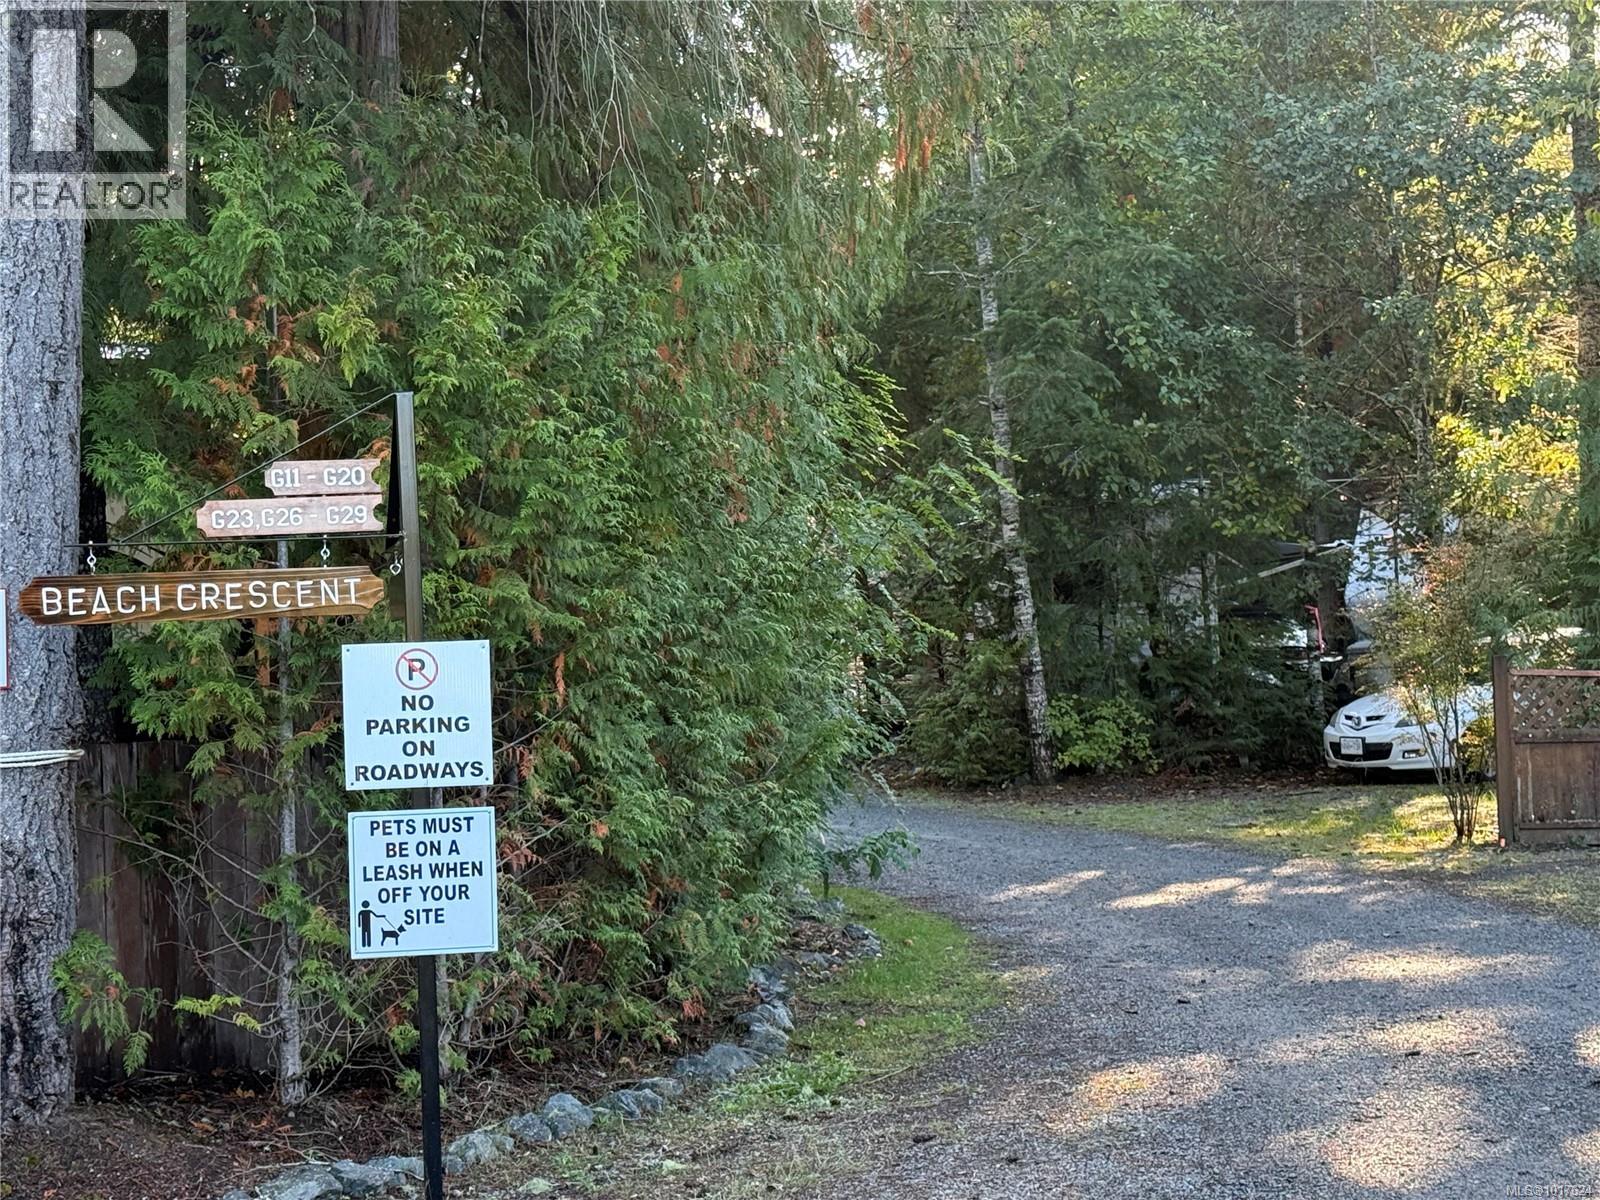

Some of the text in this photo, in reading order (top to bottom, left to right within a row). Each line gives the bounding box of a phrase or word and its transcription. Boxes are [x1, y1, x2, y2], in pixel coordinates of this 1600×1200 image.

[270, 468, 300, 488] G11
[323, 465, 366, 486] G20
[326, 504, 368, 525] G29
[41, 577, 362, 616] BEACH CRESCENT
[401, 694, 434, 711] NO
[366, 716, 470, 735] PARKING
[402, 740, 435, 757] ON
[355, 761, 484, 782] ROADWAYS
[370, 816, 474, 836] PETS MUST
[386, 839, 460, 858] BE ON A
[363, 860, 483, 882] LEASH WHEN
[378, 883, 470, 904] OFF YOUR
[404, 907, 445, 926] SITE
